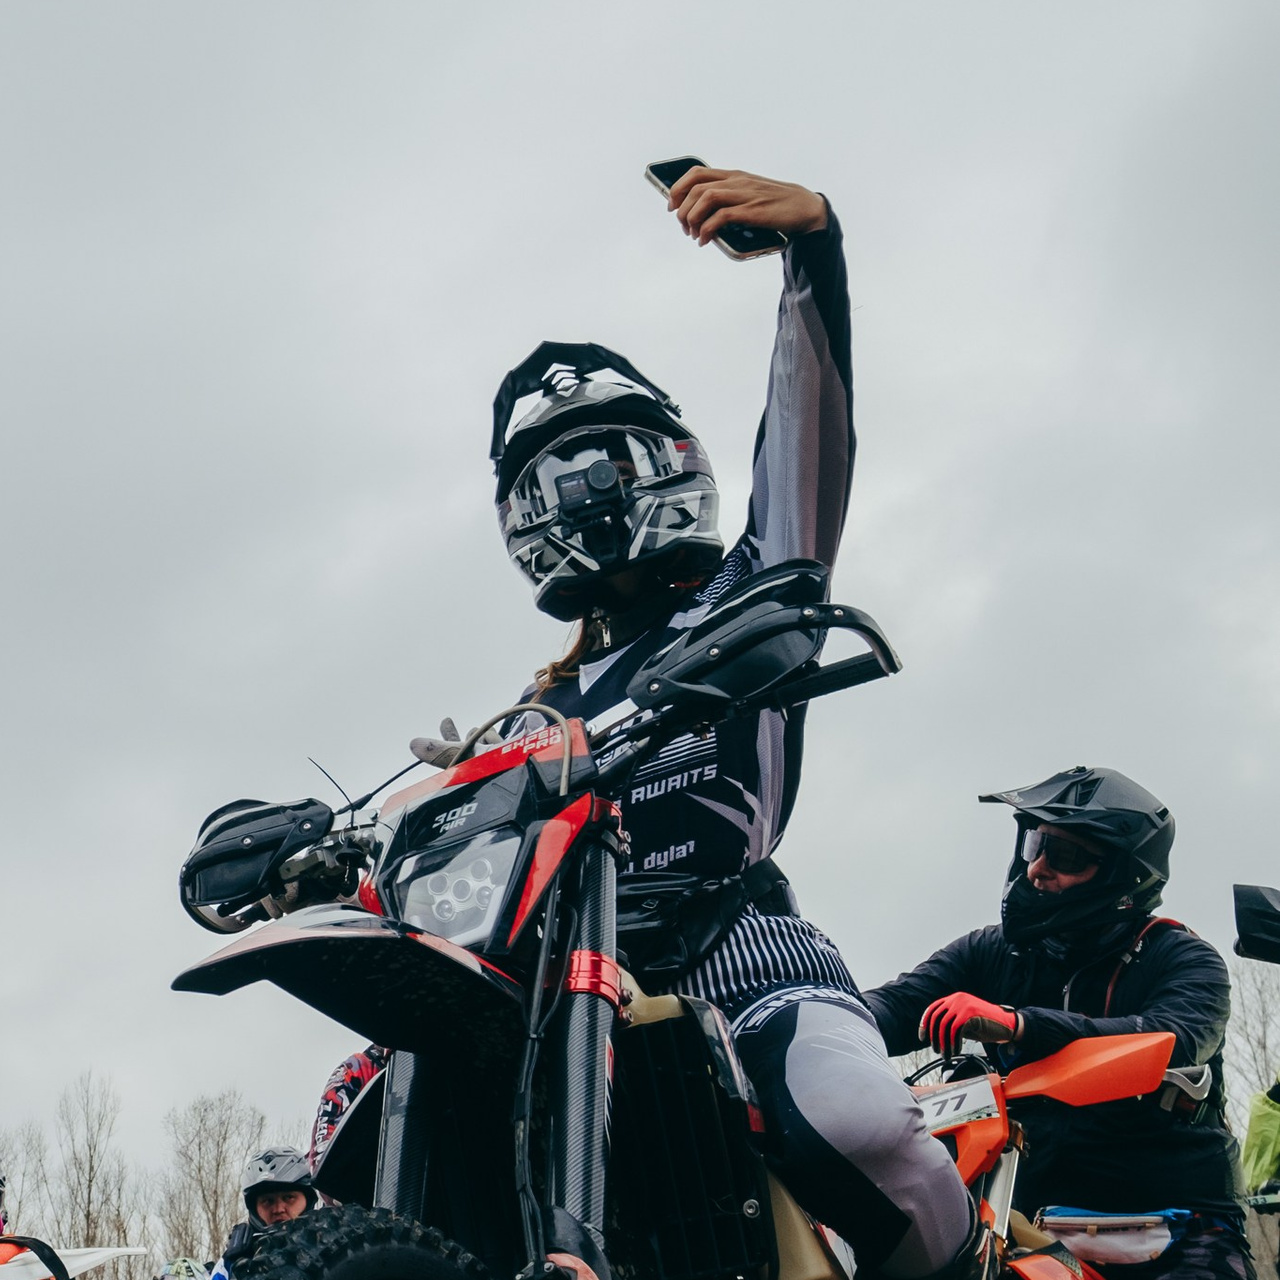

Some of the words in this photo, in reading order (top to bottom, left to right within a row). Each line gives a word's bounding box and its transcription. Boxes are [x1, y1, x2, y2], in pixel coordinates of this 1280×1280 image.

[523, 736, 562, 754] PRO
[631, 764, 718, 805] AWAITS
[431, 802, 479, 829] 300
[439, 817, 466, 834] AIR
[931, 1092, 968, 1118] 77
